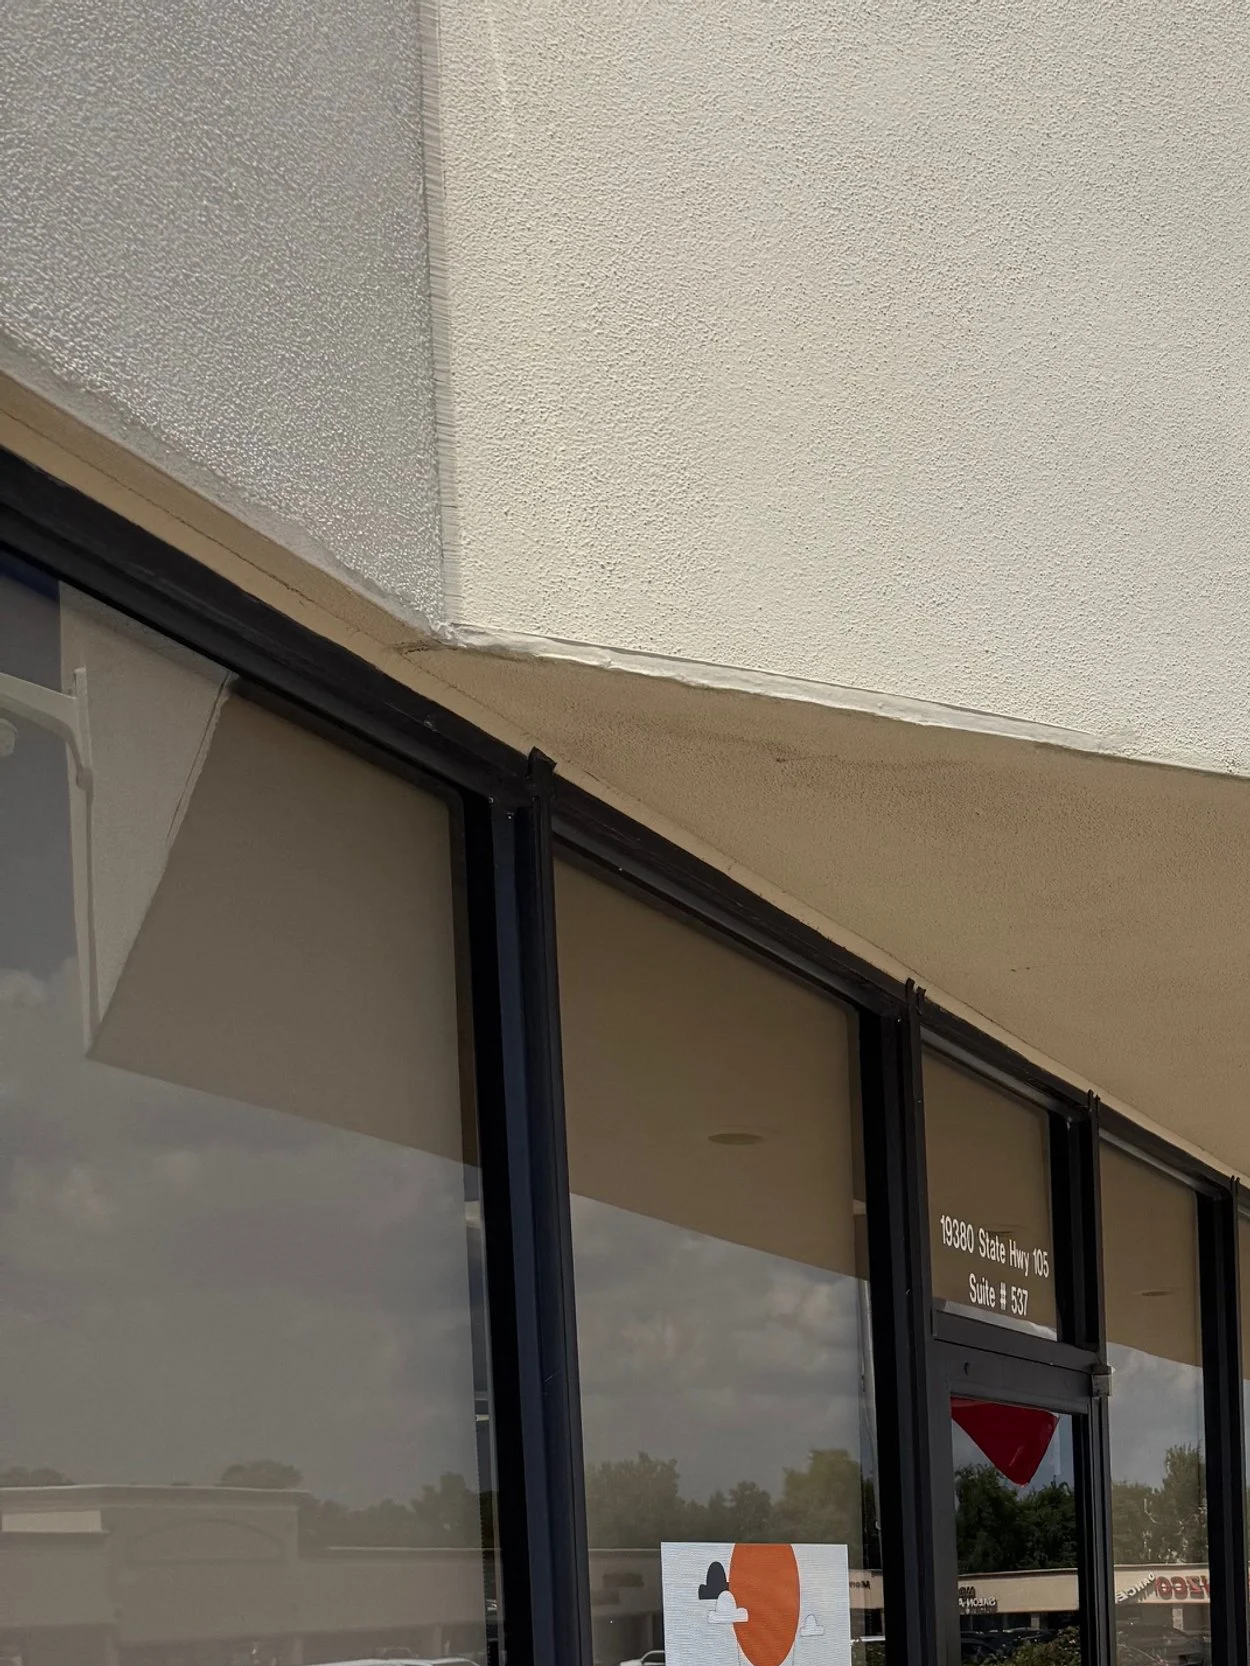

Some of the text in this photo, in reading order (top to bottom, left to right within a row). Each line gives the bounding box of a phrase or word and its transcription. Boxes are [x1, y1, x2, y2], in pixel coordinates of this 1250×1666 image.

[940, 1214, 1050, 1278] 19380 State Hwy 105
[969, 1272, 1029, 1316] Suite # 537
